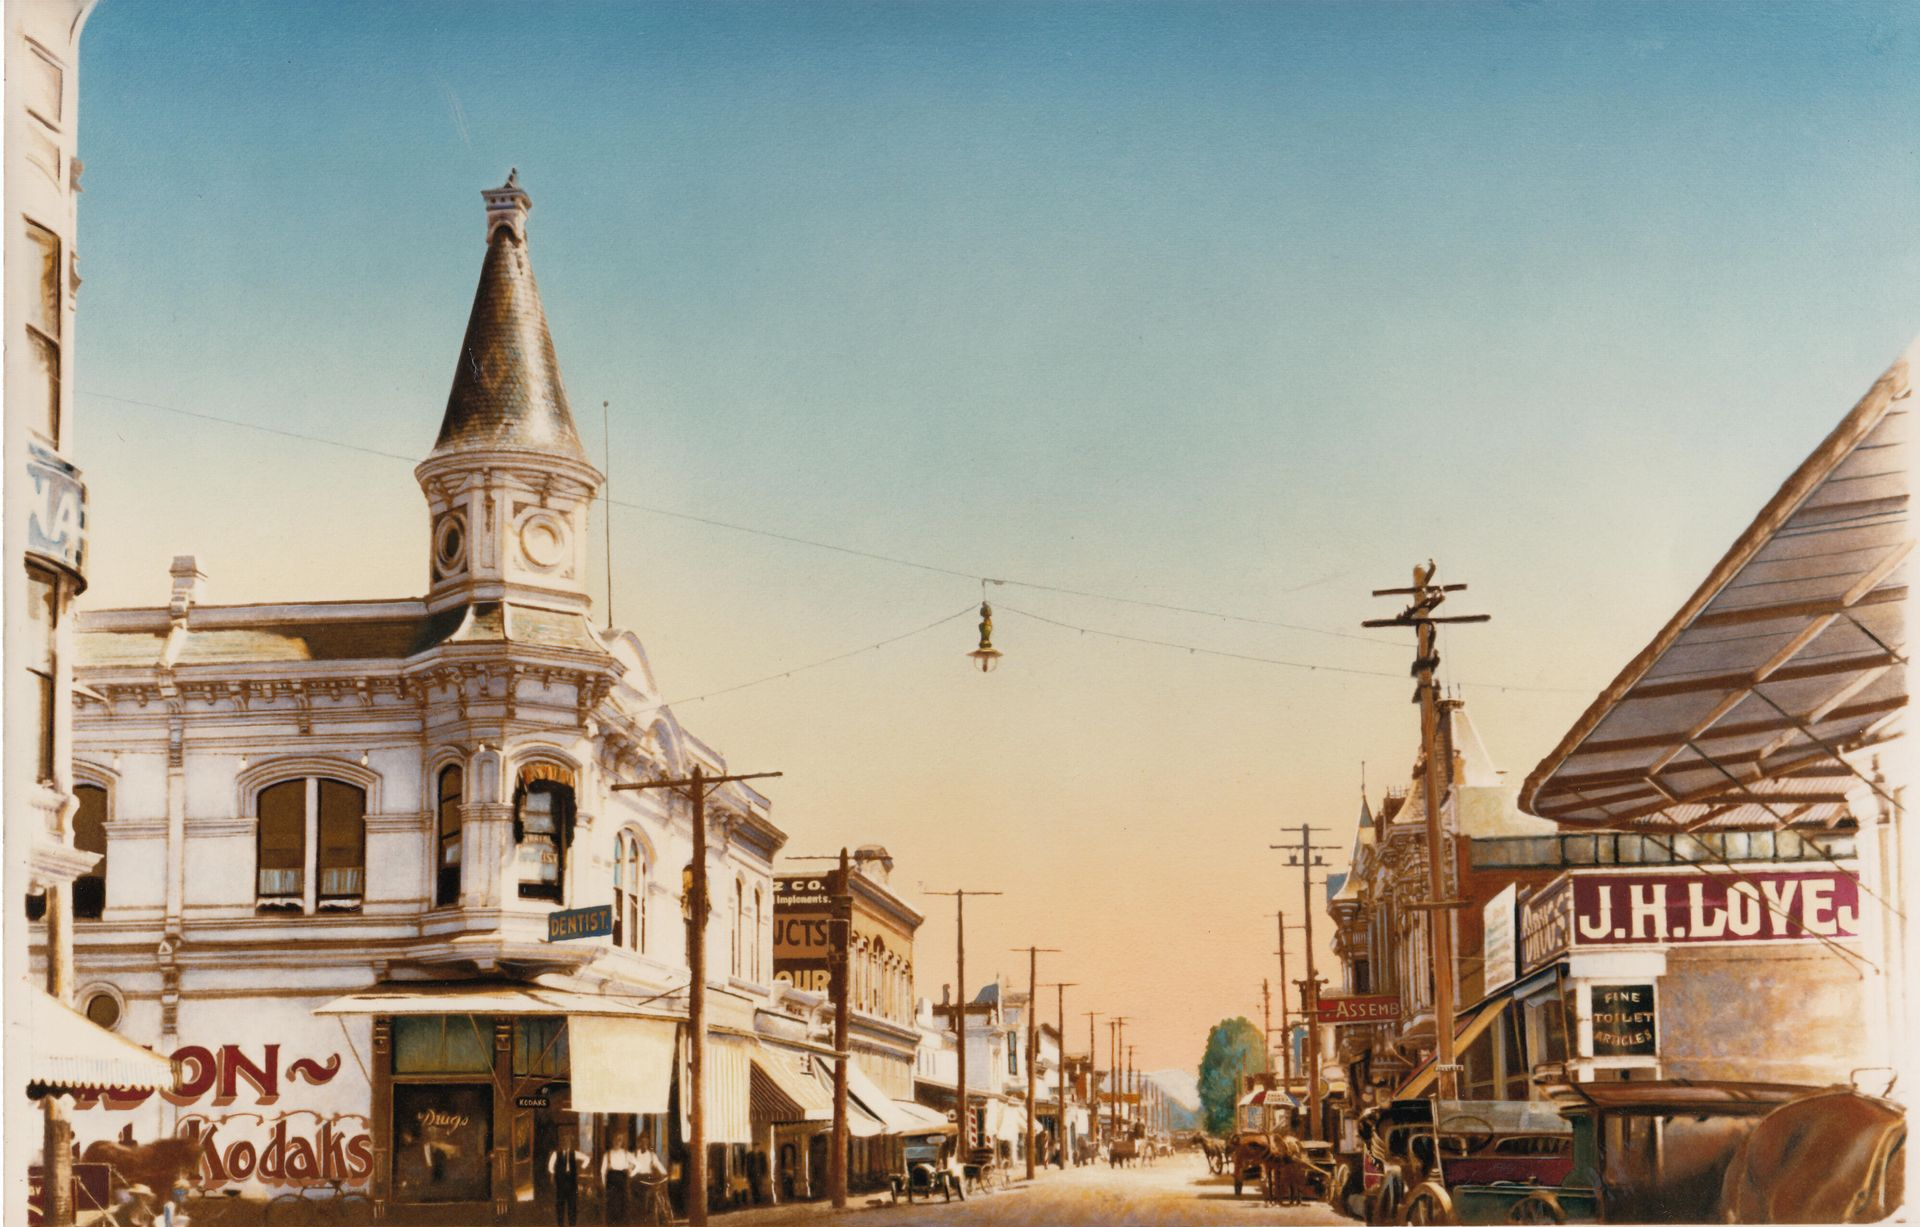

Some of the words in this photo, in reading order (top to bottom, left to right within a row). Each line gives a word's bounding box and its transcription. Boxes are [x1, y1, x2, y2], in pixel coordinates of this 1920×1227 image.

[791, 880, 826, 891] CO.
[1604, 992, 1641, 1004] FINE
[1593, 1012, 1653, 1024] TOILET
[1594, 1029, 1653, 1047] ARTICLES
[417, 1108, 470, 1137] Drugs
[180, 1117, 374, 1187] Kodaks
